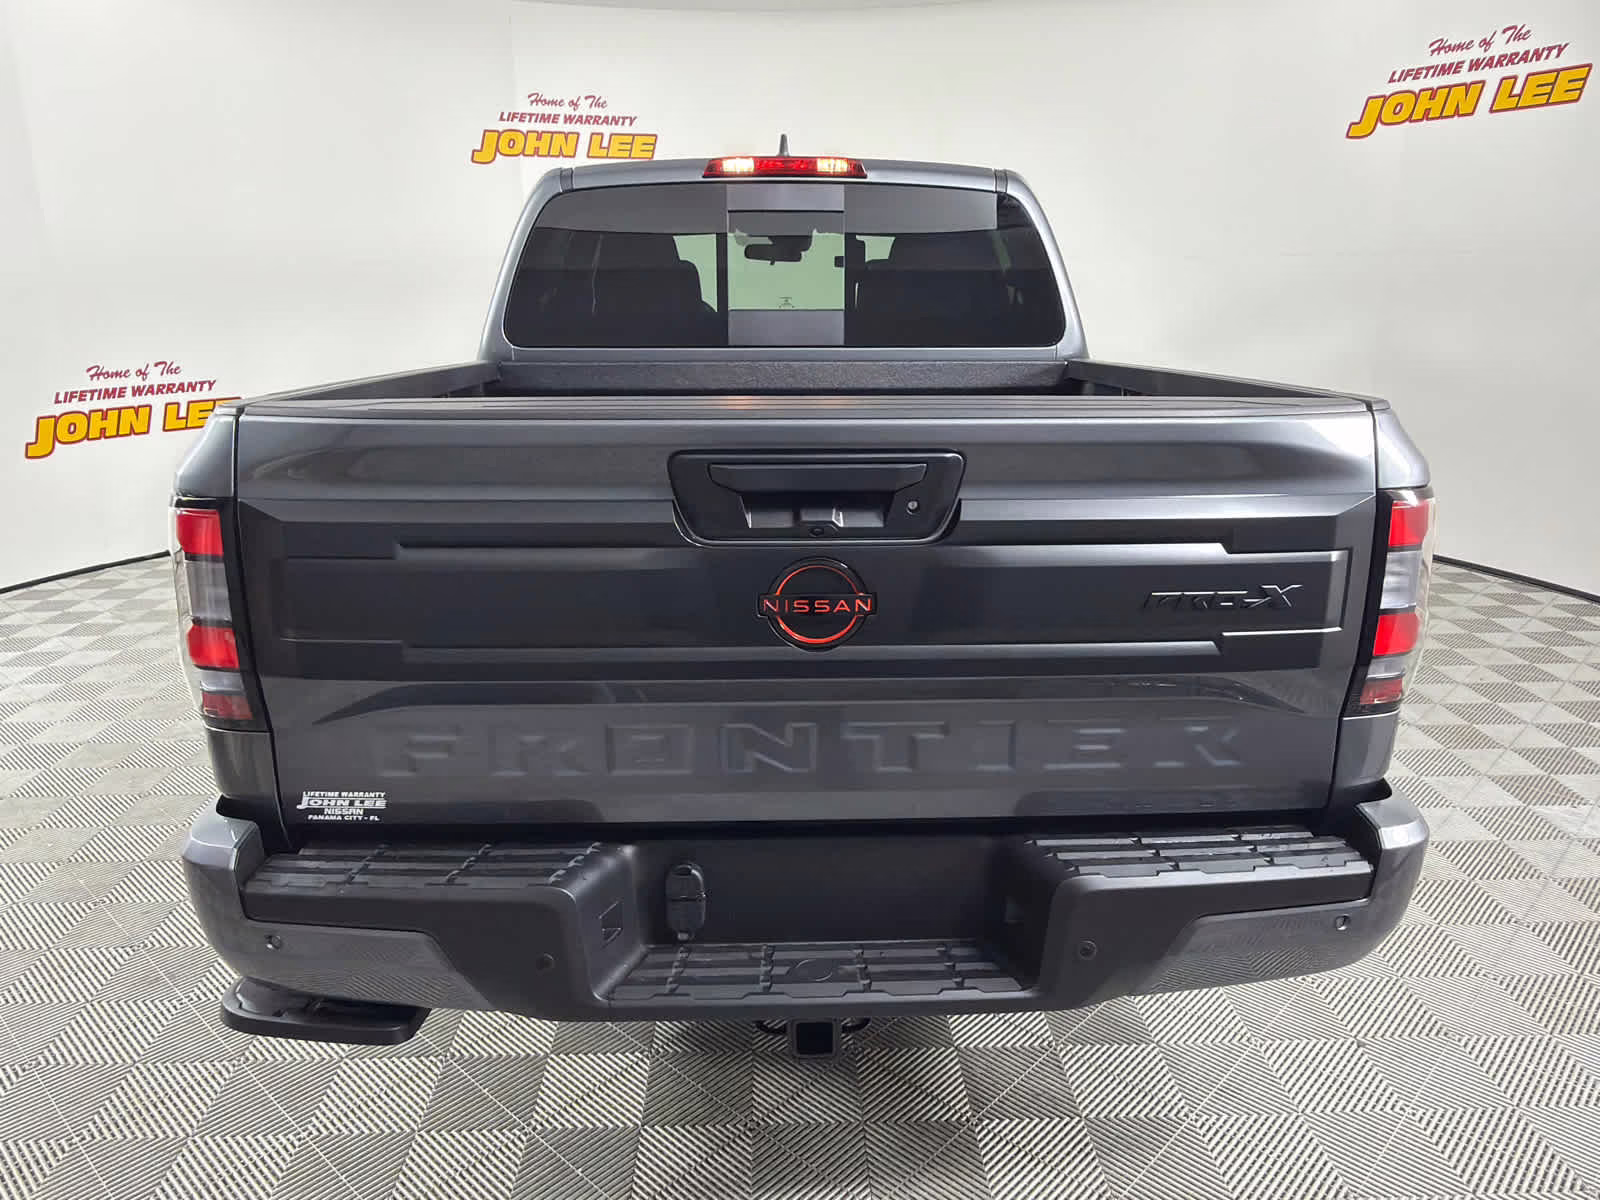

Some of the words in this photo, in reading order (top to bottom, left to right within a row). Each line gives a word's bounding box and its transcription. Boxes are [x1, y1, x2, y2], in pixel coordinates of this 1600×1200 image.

[1428, 38, 1474, 56] Home
[1478, 30, 1497, 50] of
[1501, 24, 1531, 44] The
[1388, 60, 1465, 84] LIFETIME
[1467, 42, 1569, 73] WARRANTY
[527, 93, 565, 108] Home
[568, 95, 581, 111] of
[584, 95, 608, 109] The
[1346, 80, 1487, 138] JOHN
[1488, 63, 1593, 113] LEE
[498, 112, 560, 124] LIFETIME
[563, 114, 638, 127] WARRANTY
[471, 129, 580, 164] JOHN
[587, 132, 658, 160] LEE
[86, 365, 130, 381] Home
[135, 363, 150, 381] of
[153, 361, 182, 377] The
[53, 387, 127, 404] LIFETIME
[131, 379, 216, 398] WARRANTY
[25, 404, 153, 459] JOHN
[162, 396, 242, 432] LE
[763, 598, 872, 613] NISSAN
[374, 716, 1244, 777] FRONTIER
[296, 797, 350, 809] JOHN
